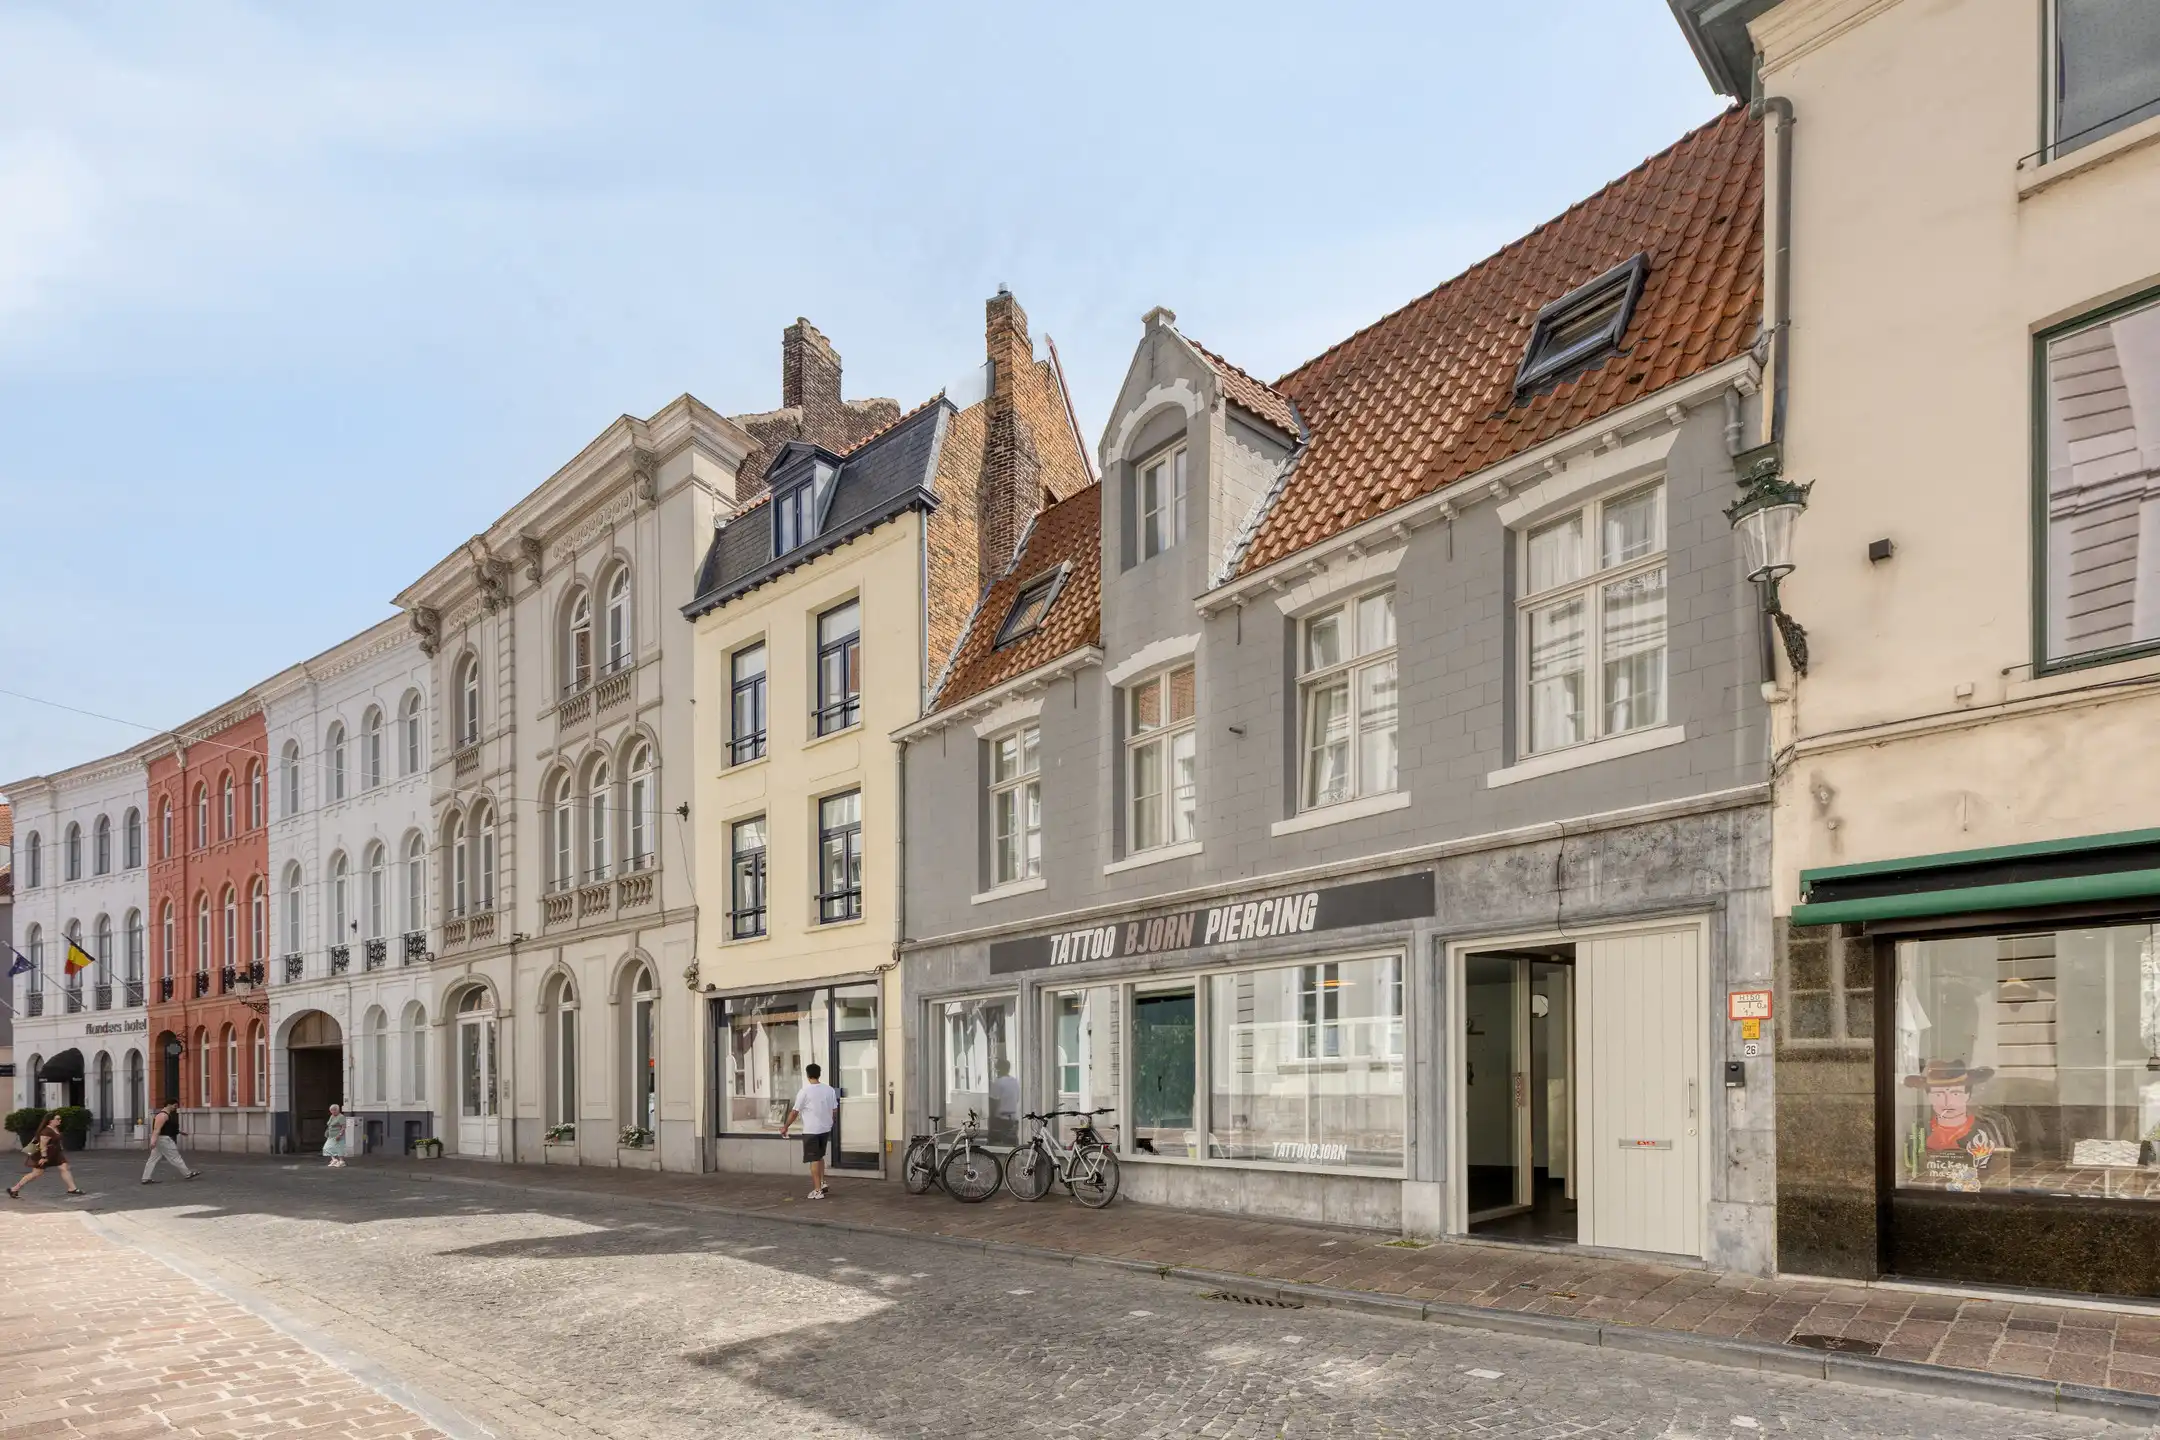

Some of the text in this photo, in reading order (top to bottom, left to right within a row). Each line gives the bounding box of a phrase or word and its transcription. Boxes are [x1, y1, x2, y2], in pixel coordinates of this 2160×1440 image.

[1050, 892, 1319, 966] TATTOO BJORN PIERCING
[124, 1018, 147, 1031] hotel
[1746, 1045, 1756, 1055] 26
[1272, 1141, 1348, 1160] TATTOOBJORN
